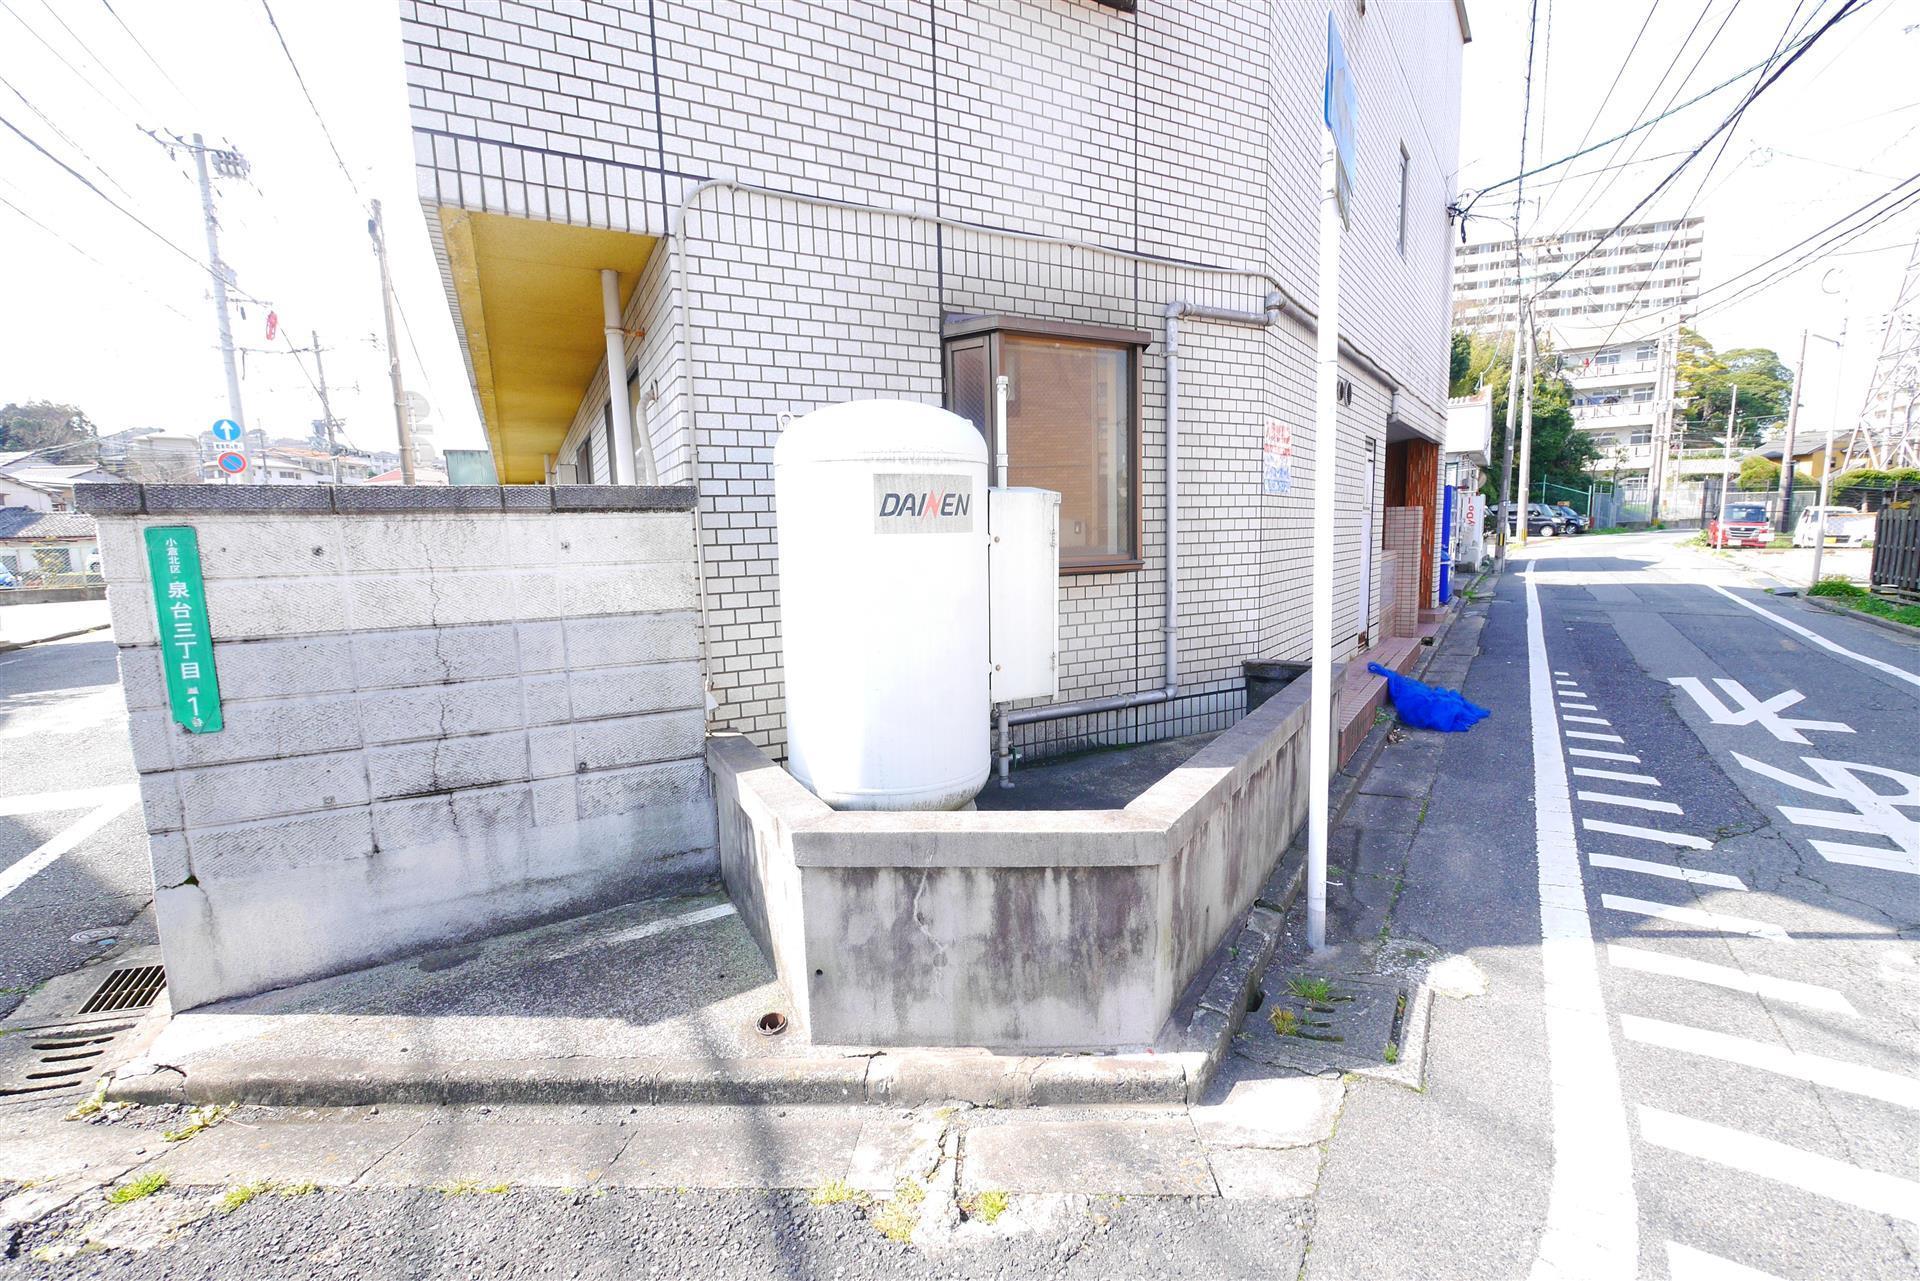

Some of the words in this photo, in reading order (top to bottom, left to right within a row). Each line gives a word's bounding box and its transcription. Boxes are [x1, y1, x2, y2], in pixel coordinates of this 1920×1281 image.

[879, 487, 971, 522] DAINEN
[165, 537, 182, 574] 小倉北区
[168, 581, 200, 680] 泉台三丁目
